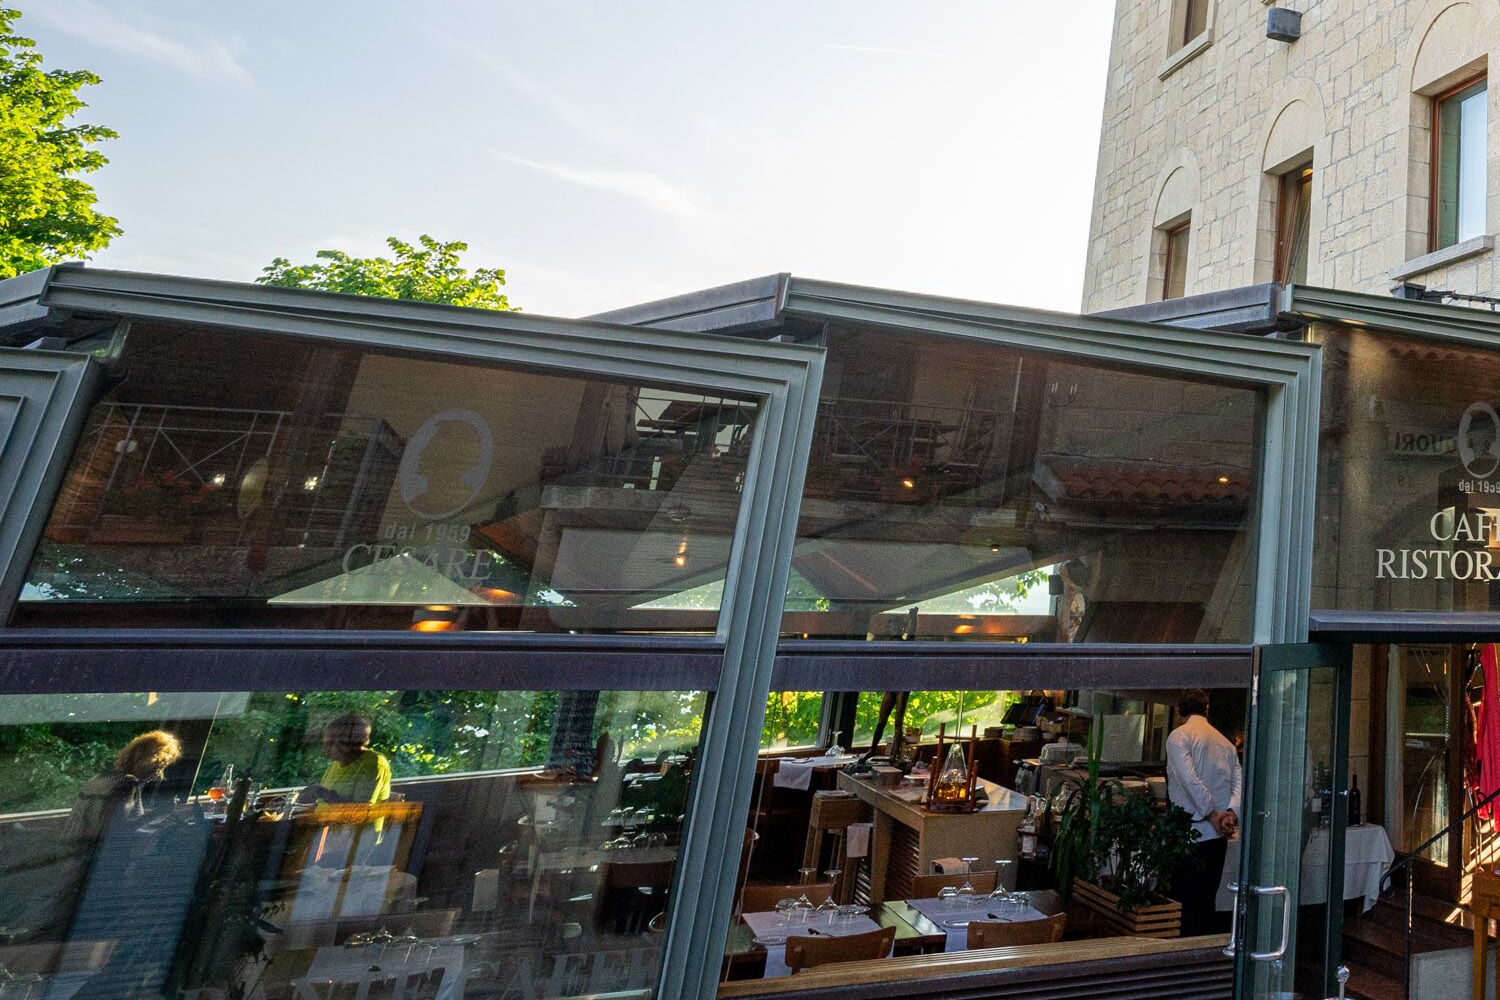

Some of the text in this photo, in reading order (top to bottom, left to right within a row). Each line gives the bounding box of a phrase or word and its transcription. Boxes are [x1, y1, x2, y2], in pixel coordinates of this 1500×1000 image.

[1458, 479, 1474, 492] dal
[384, 521, 472, 543] dal 1959
[342, 543, 493, 581] CESARE
